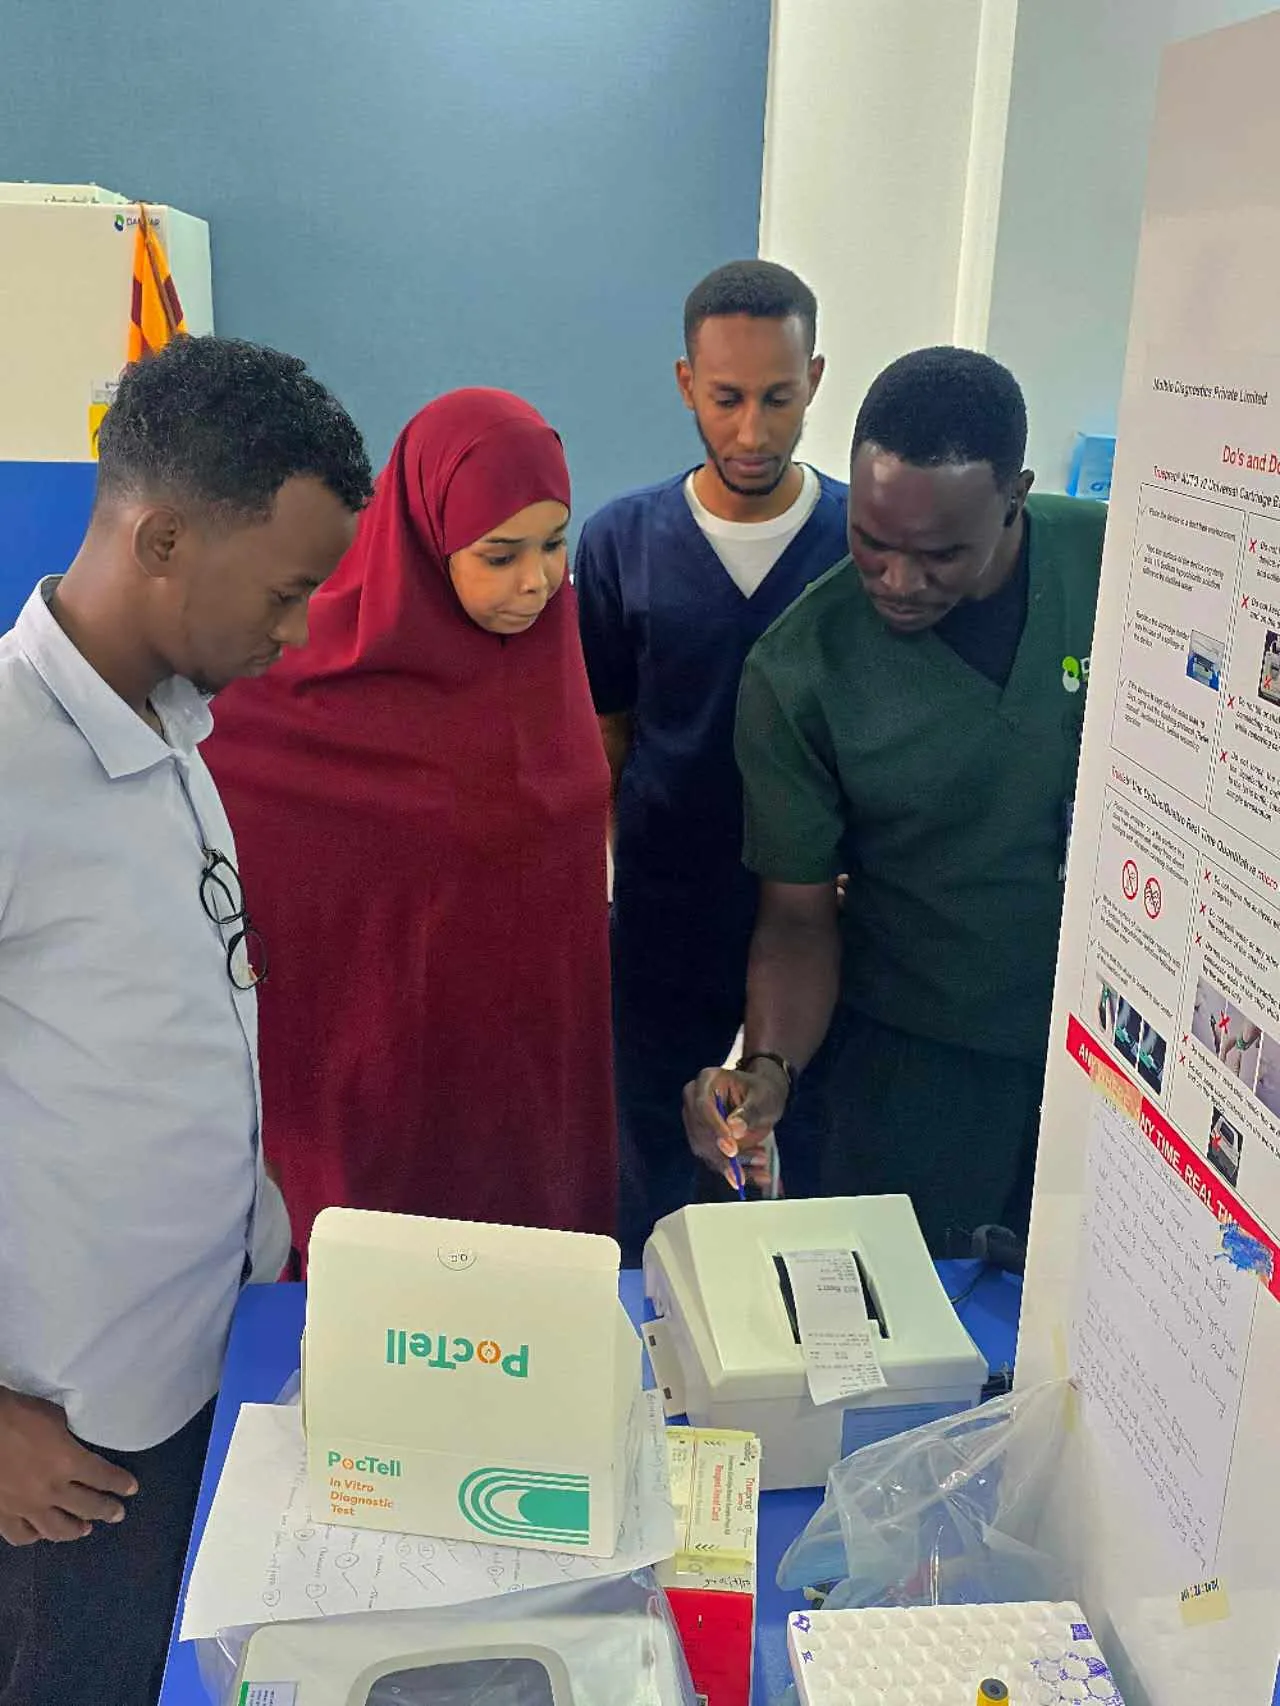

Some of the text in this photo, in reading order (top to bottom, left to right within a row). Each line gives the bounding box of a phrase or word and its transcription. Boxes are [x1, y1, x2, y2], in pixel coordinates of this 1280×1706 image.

[1213, 386, 1238, 401] Private
[1239, 389, 1268, 405] Limited
[1222, 445, 1244, 466] Do's
[1246, 454, 1266, 471] and
[1258, 868, 1278, 890] micro
[1185, 1163, 1214, 1212] REAL
[384, 1328, 530, 1378] PocTell
[327, 1451, 402, 1478] PocTell
[329, 1477, 374, 1493] In Vitro
[329, 1491, 395, 1510] Diagnostic
[330, 1503, 356, 1517] Test
